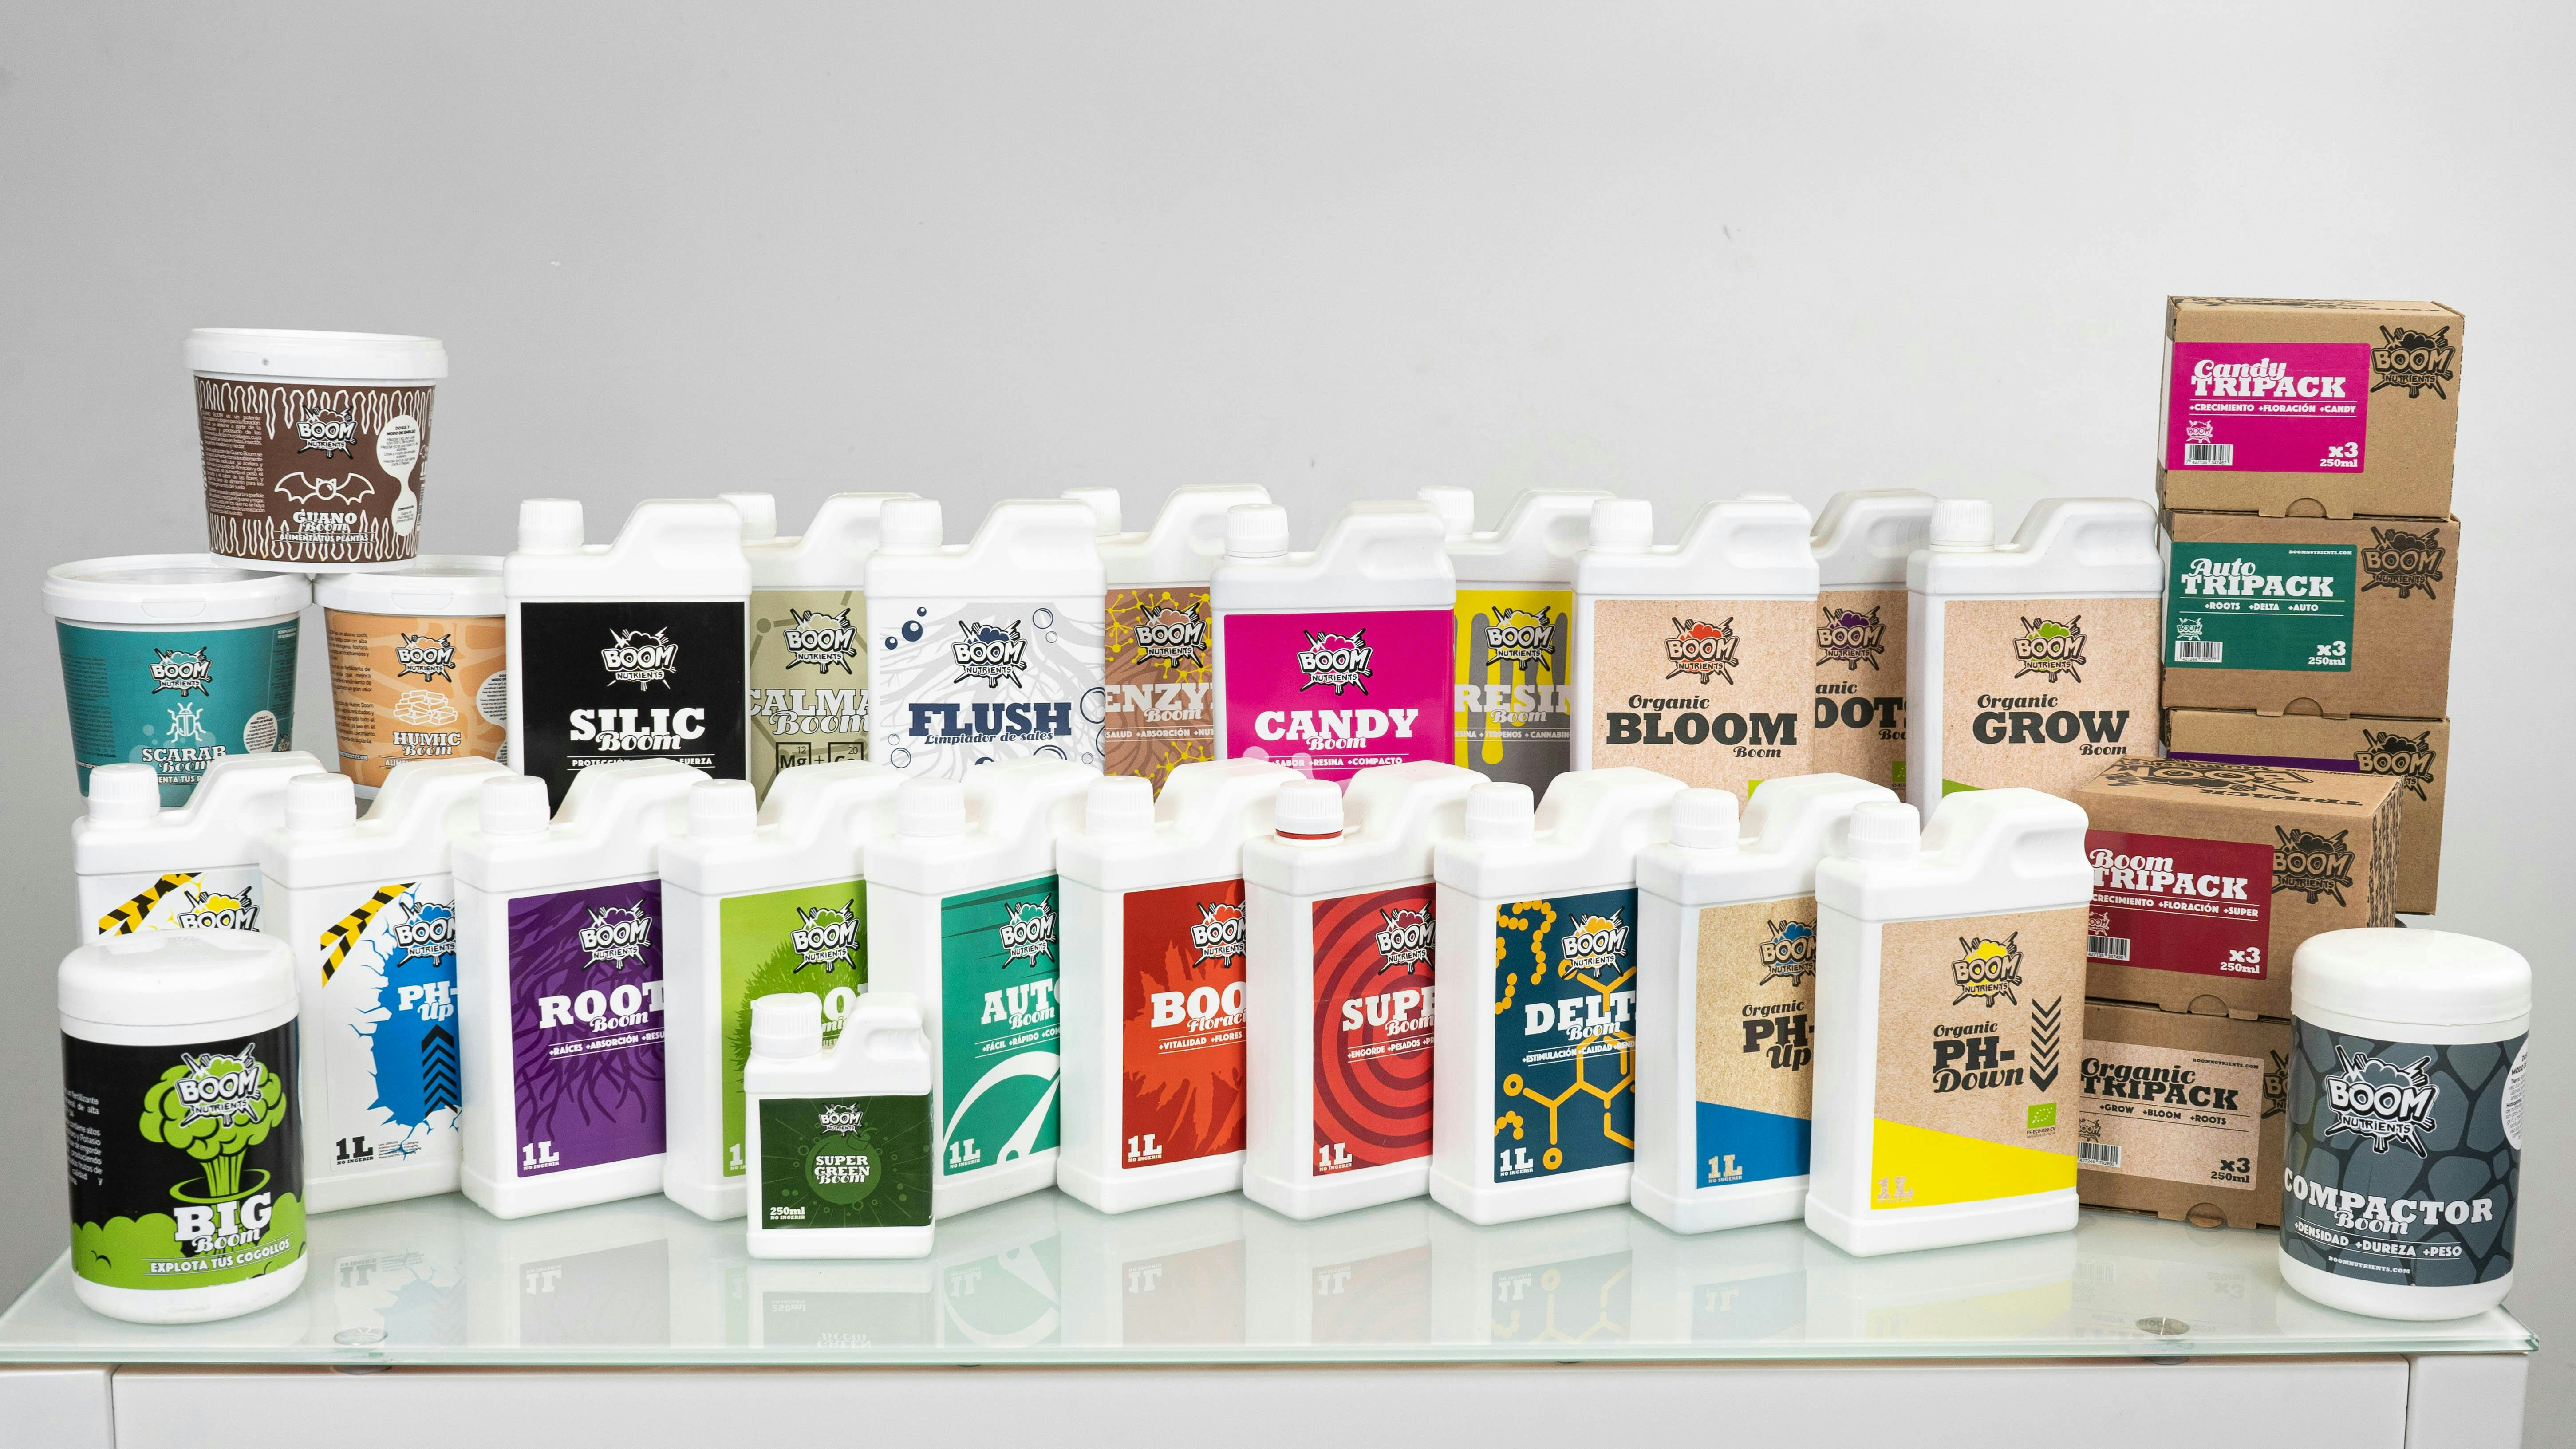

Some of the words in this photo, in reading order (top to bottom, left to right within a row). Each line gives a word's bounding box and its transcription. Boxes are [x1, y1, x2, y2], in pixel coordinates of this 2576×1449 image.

[2194, 358, 2286, 380] Candy
[2378, 348, 2453, 373] BOOM
[2191, 376, 2346, 398] TRIPACK
[2385, 374, 2435, 383] NUTRIENTS
[2190, 403, 2254, 412] +CRECIMIENTO
[2258, 403, 2316, 413] +FLORACIÓN
[2320, 405, 2356, 413] +CANDY
[299, 422, 355, 440] BOOM
[2329, 442, 2358, 457] x3
[2320, 458, 2357, 467] 250ml
[293, 511, 357, 524] GUANO
[303, 523, 348, 532] Boom
[280, 534, 318, 542] ALIMENTA
[2189, 558, 2256, 577] Auto
[2366, 550, 2440, 575] BOOM
[2182, 575, 2333, 597] TRIPACK
[786, 629, 854, 649] BOOM
[1138, 623, 1203, 645] BOOM
[1487, 626, 1552, 647] BOOM
[1819, 625, 1884, 646] BOOM
[399, 648, 454, 663] BOOM
[604, 646, 674, 668] BOOM
[955, 641, 1024, 663] BOOM
[1668, 637, 1737, 660] BOOM
[2016, 636, 2085, 658] BOOM
[2317, 641, 2346, 656] x3
[152, 662, 210, 679] BOOM
[1300, 649, 1370, 672] BOOM
[2308, 656, 2345, 665] 250ml
[1628, 694, 1710, 711] Organic
[1977, 694, 2058, 711] Organic
[570, 708, 705, 741] SILIC
[909, 702, 1072, 736] FLUSH
[1144, 708, 1202, 723] Boom
[1255, 709, 1419, 741] CANDY
[1490, 709, 1546, 724] Boom
[924, 734, 996, 745] Limpiador
[1000, 733, 1014, 742] de
[1021, 731, 1053, 741] sales
[1136, 728, 1190, 737] +ABSORCIÓN
[1606, 712, 1797, 745] BLOOM
[1972, 711, 2129, 744] GROW
[393, 732, 461, 746] HUMIC
[596, 731, 681, 751] Boom
[1306, 736, 1366, 751] Boom
[2079, 744, 2127, 755] Boom
[142, 746, 226, 762] SCARAB
[402, 744, 452, 756] Boom
[1733, 746, 1781, 758] Boom
[2090, 848, 2174, 872] Boom
[2093, 868, 2248, 900] TRIPACK
[2282, 877, 2335, 889] NUTRIENTS
[2158, 901, 2219, 914] +FLORACIÓN
[2223, 907, 2258, 917] +SUPER
[582, 921, 649, 949] BOOM
[795, 922, 856, 948] BOOM
[1002, 914, 1053, 945] BOOM
[1204, 944, 1243, 956] NUTRIENTS
[1565, 929, 1625, 957] BOOM
[2229, 947, 2260, 963] x3
[1955, 953, 2020, 981] BOOM
[2220, 962, 2260, 974] 250ml
[1965, 983, 2007, 993] NUTRIENTS
[417, 1002, 454, 1022] Up
[1009, 1006, 1054, 1030] Boom
[1742, 1000, 1804, 1020] Organic
[590, 1012, 649, 1032] Boom
[1566, 1020, 1621, 1041] Boom
[1933, 1021, 1997, 1038] Organic
[549, 1044, 583, 1056] +RAÍCES
[586, 1034, 639, 1051] +ABSORCIÓN
[982, 1040, 1006, 1053] +FÁCIL
[1009, 1031, 1039, 1047] +RÁPIDO
[1159, 1037, 1207, 1051] +VITALIDAD
[1211, 1031, 1242, 1043] +FLORES
[1347, 1045, 1385, 1059] +ENGORDE
[1387, 1039, 1420, 1052] +PESADOS
[1523, 1048, 1577, 1063] +ESTIMULACIÓN
[1578, 1043, 1613, 1055] +CALIDAD
[1766, 1044, 1811, 1071] Up
[1933, 1036, 2014, 1074] PH-
[2192, 1058, 2259, 1069] BOOMNUTRIENTS.COM
[1933, 1067, 2024, 1094] Down
[2081, 1057, 2196, 1084] Organic
[180, 1069, 256, 1102] BOOM
[2081, 1075, 2238, 1110] TRIPACK
[2331, 1079, 2432, 1122] BOOM
[821, 1113, 860, 1125] BOOM
[2100, 1104, 2134, 1114] +GROW
[2143, 1109, 2181, 1119] +BLOOM
[2190, 1115, 2226, 1125] +ROOTS
[336, 1136, 373, 1160] 1L
[523, 1141, 559, 1166] 1L
[950, 1138, 980, 1165] 1L
[1128, 1134, 1162, 1158] 1L
[1319, 1142, 1352, 1167] 1L
[533, 1161, 559, 1170] INGERIR
[816, 1156, 868, 1166] SUPER
[1500, 1147, 1533, 1173] 1L
[1708, 1154, 1742, 1178] 1L
[2220, 1158, 2250, 1173] x3
[814, 1166, 870, 1177] GREEN
[817, 1173, 865, 1184] Boom
[2210, 1171, 2250, 1183] 250ml
[1878, 1177, 1913, 1198] 1L
[2284, 1167, 2493, 1225] COMPACTOR
[174, 1192, 272, 1242] BIG
[770, 1207, 805, 1215] 250ml
[2334, 1210, 2408, 1235] Boom
[192, 1227, 260, 1254] Boom
[2294, 1221, 2349, 1247] +DENSIDAD
[2355, 1240, 2416, 1256] +DUREZA
[2423, 1245, 2462, 1257] +PESO
[150, 1259, 209, 1274] EXPLOTA
[211, 1256, 234, 1269] TUS
[236, 1239, 289, 1265] COGOLLOS
[2328, 1256, 2410, 1274] BOOMNUTRIENTS.COM
